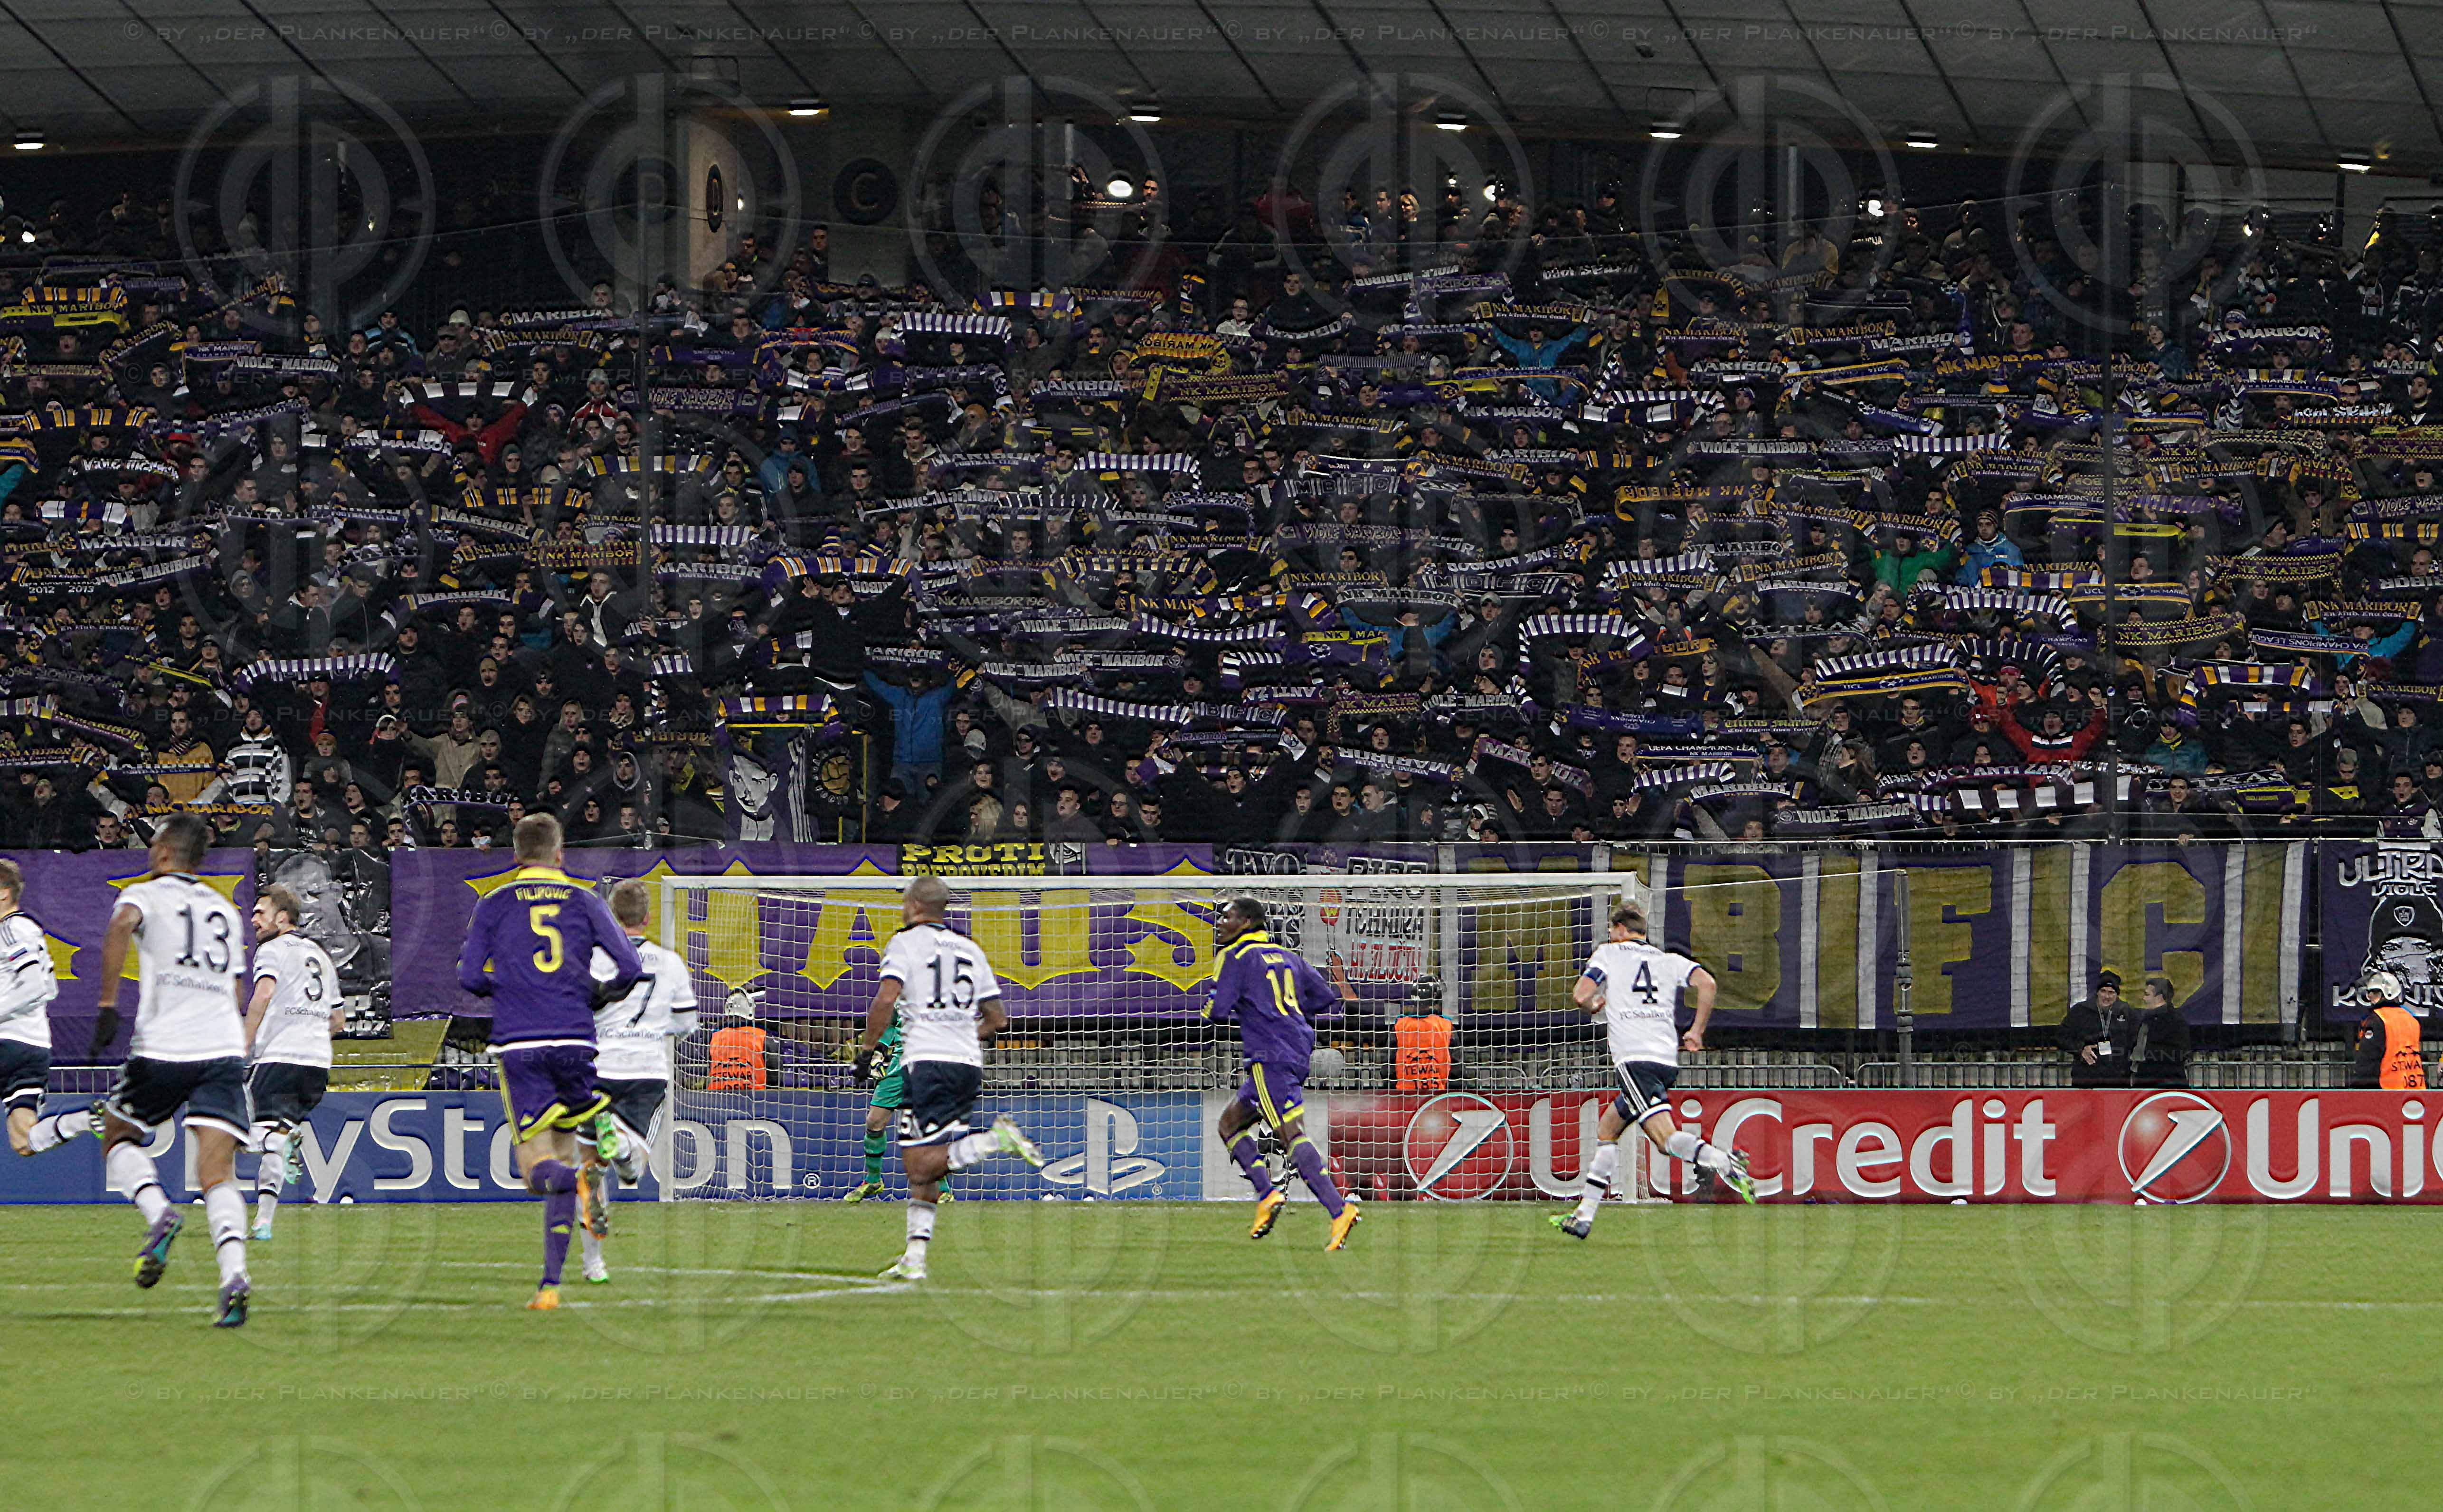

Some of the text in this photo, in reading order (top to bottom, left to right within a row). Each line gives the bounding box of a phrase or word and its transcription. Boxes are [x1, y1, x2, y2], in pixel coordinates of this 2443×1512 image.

[31, 303, 48, 312] NK
[1805, 328, 1822, 338] NK
[2239, 326, 2320, 340] MARIBOR
[237, 357, 339, 371] VIOLE MARIBOR
[1937, 361, 1961, 375] NK
[1464, 406, 1563, 419] NK MARIBOR
[1701, 441, 1808, 454] VIOLE MARIBOR
[1881, 512, 1943, 529] MARIBOR
[79, 536, 186, 550] MARIBOR
[547, 549, 634, 559] NK MARIBOR
[657, 562, 763, 578] MARIBOR
[2237, 562, 2336, 575] NK MARIBOR
[1290, 573, 1382, 582] NK MARIBOR
[29, 586, 55, 594] 2012
[1340, 588, 1457, 602] NK MARIBOR
[958, 596, 1024, 607] MARIBOR
[1139, 598, 1159, 609] NK
[1021, 617, 1130, 633] VIOLE MARIBOR
[2119, 622, 2225, 640] NK MARIBOR
[1101, 653, 1165, 667] MARIBOR
[146, 803, 275, 816] NK MARIBOR
[1798, 803, 1910, 823] VIOLE MARIBOR
[902, 843, 1045, 863] PROTI
[175, 903, 230, 973] 13
[530, 904, 565, 973] 5
[304, 956, 323, 1002] 3
[927, 954, 974, 1008] 15
[1632, 961, 1658, 1004] 4
[1265, 967, 1304, 1016] 14
[105, 1098, 792, 1204] PlyStaon
